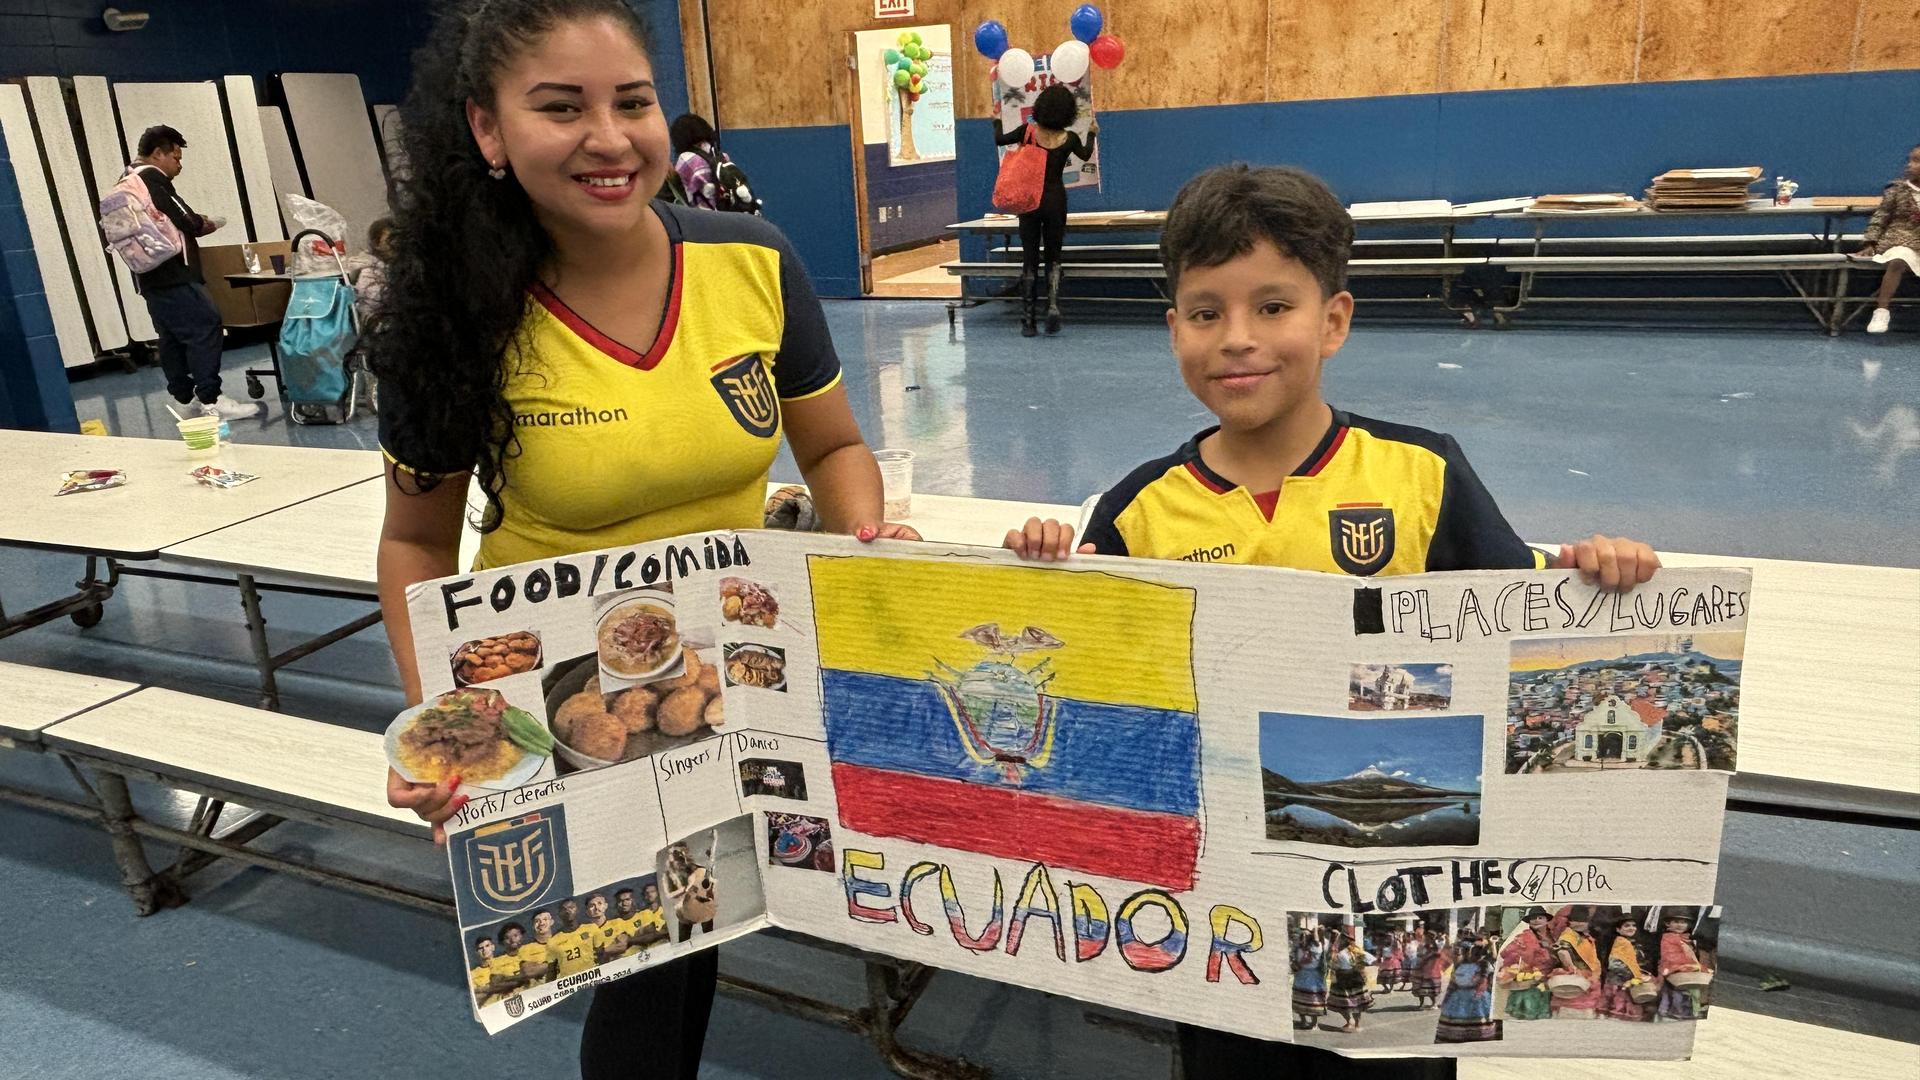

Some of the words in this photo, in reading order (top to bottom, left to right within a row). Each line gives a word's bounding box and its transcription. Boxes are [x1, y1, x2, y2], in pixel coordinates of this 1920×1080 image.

[515, 406, 628, 427] marathon
[842, 848, 1264, 985] ECUADOR
[565, 946, 581, 961] 23
[556, 968, 602, 990] ECUADOR
[528, 995, 552, 1011] SQUAD
